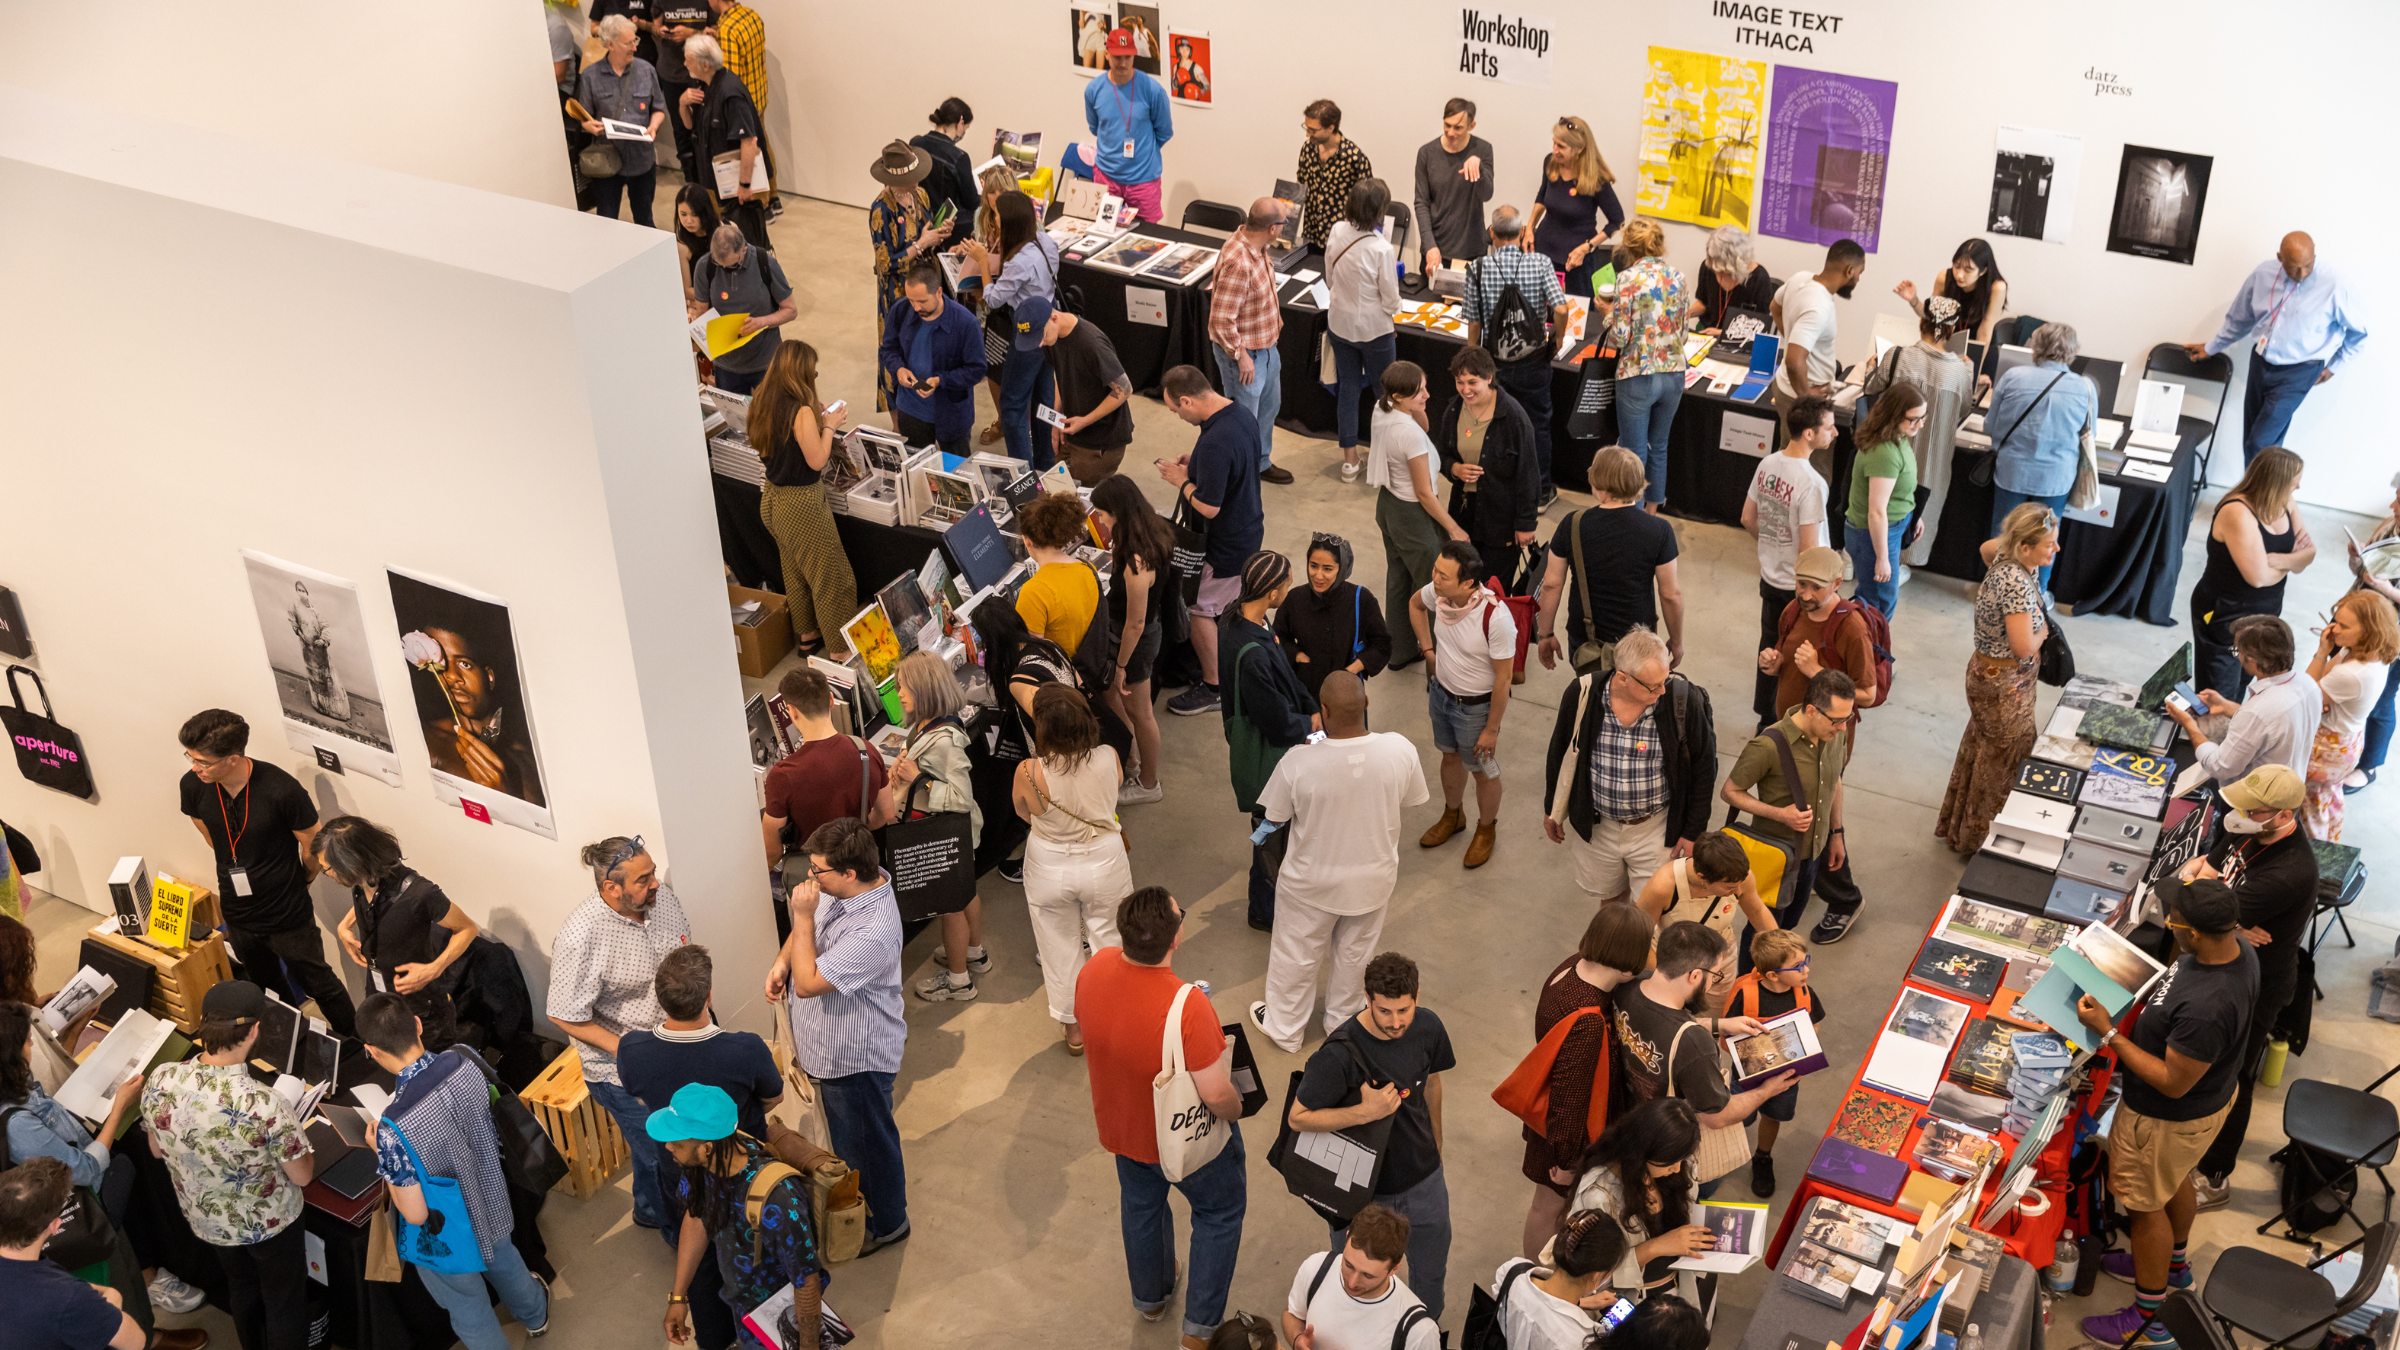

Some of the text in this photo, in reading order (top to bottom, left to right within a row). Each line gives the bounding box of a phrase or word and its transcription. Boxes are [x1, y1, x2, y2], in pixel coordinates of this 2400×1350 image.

[1713, 0, 1843, 33] IMAGE TEXT
[1463, 8, 1549, 58] Workshop
[1736, 26, 1813, 54] ITHACA
[1460, 42, 1498, 78] Arts
[2084, 66, 2118, 83] datz
[2095, 83, 2132, 97] press
[1014, 476, 1036, 496] SÉANCE
[974, 540, 995, 561] ELEMENTS
[15, 734, 78, 762] aperture
[894, 844, 922, 854] Photography
[928, 837, 959, 847] demonstrably
[915, 845, 947, 855] contemporary
[918, 862, 953, 871] communication
[926, 856, 947, 865] universal
[930, 867, 950, 875] between
[158, 888, 184, 906] EL LIBRO
[158, 900, 183, 918] SUPREMO
[119, 914, 139, 926] 03
[154, 918, 178, 935] SUERTE
